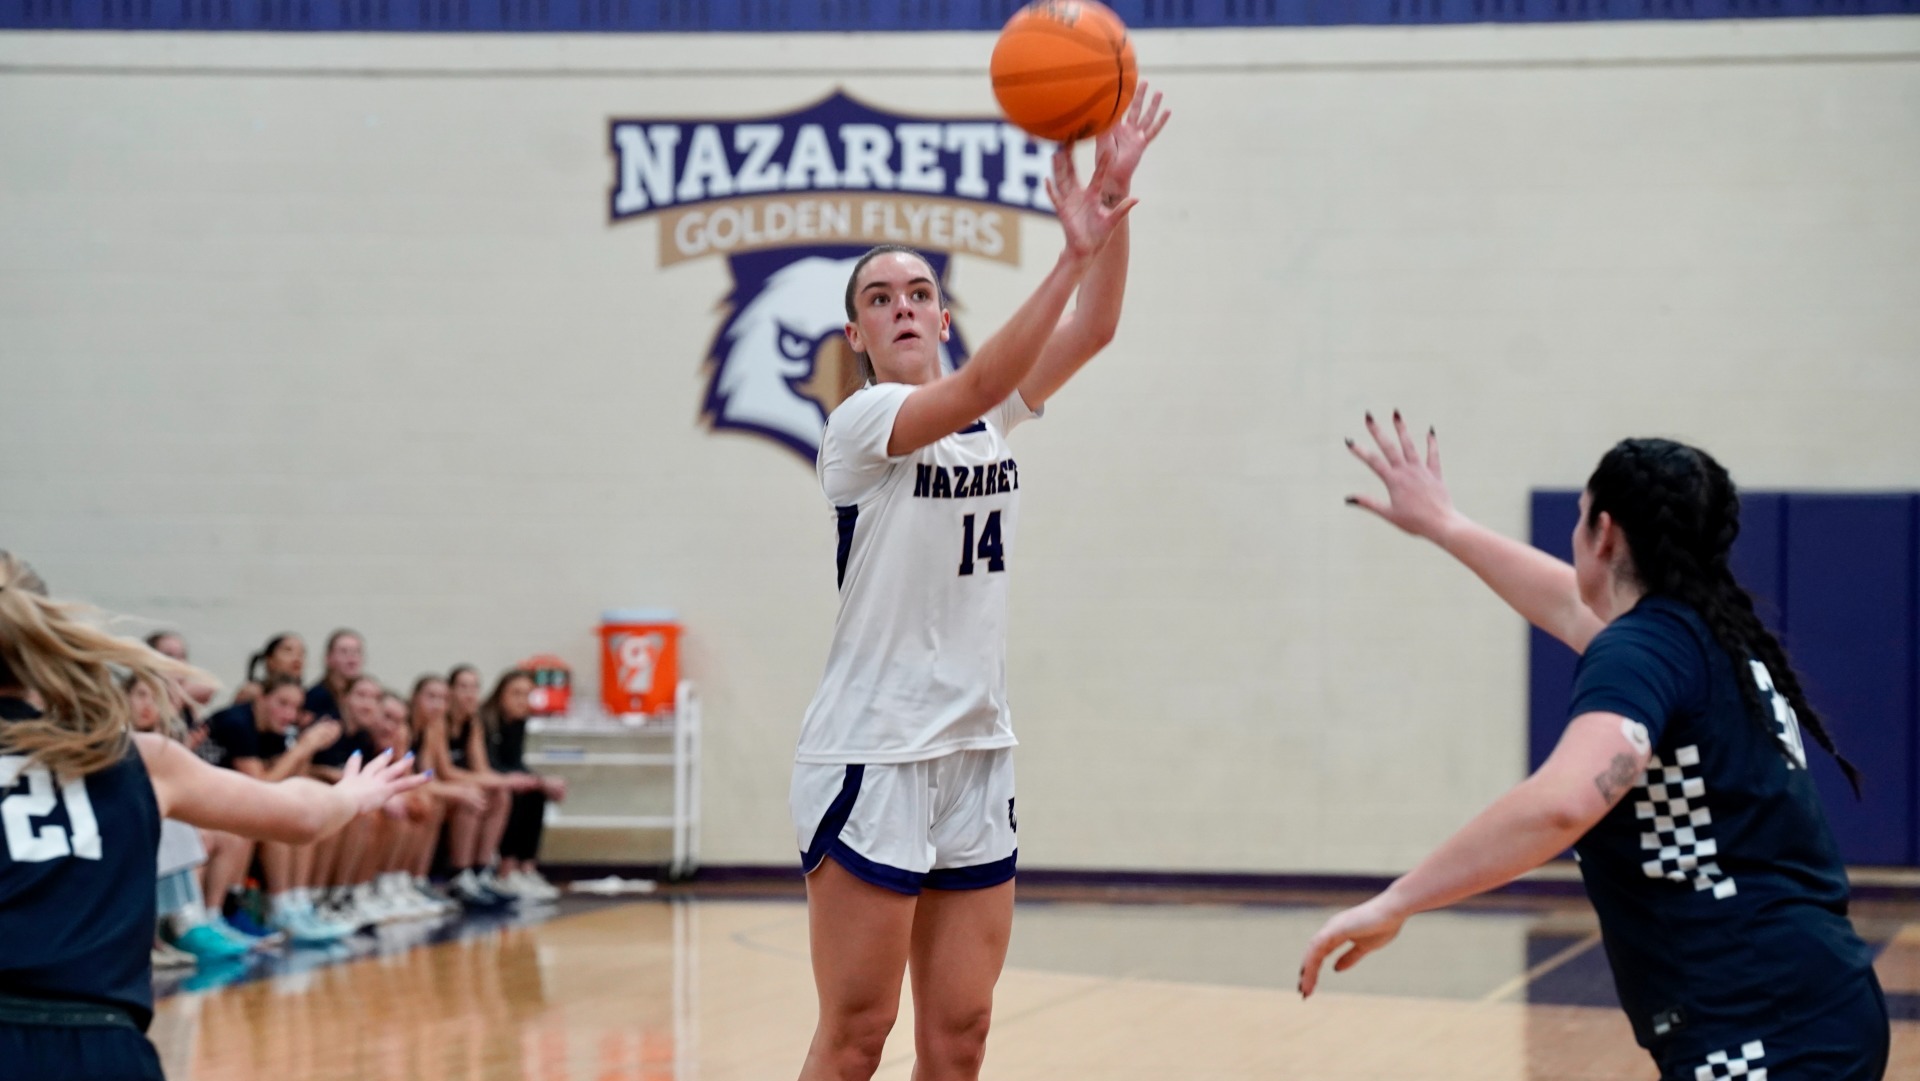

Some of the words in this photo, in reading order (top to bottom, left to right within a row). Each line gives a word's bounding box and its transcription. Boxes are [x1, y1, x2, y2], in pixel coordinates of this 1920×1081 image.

[615, 123, 1056, 214] NAZARETH
[675, 201, 853, 256] GOLDEN
[862, 200, 1003, 254] FLYERS
[958, 509, 1005, 577] 14
[0, 755, 102, 862] 21
